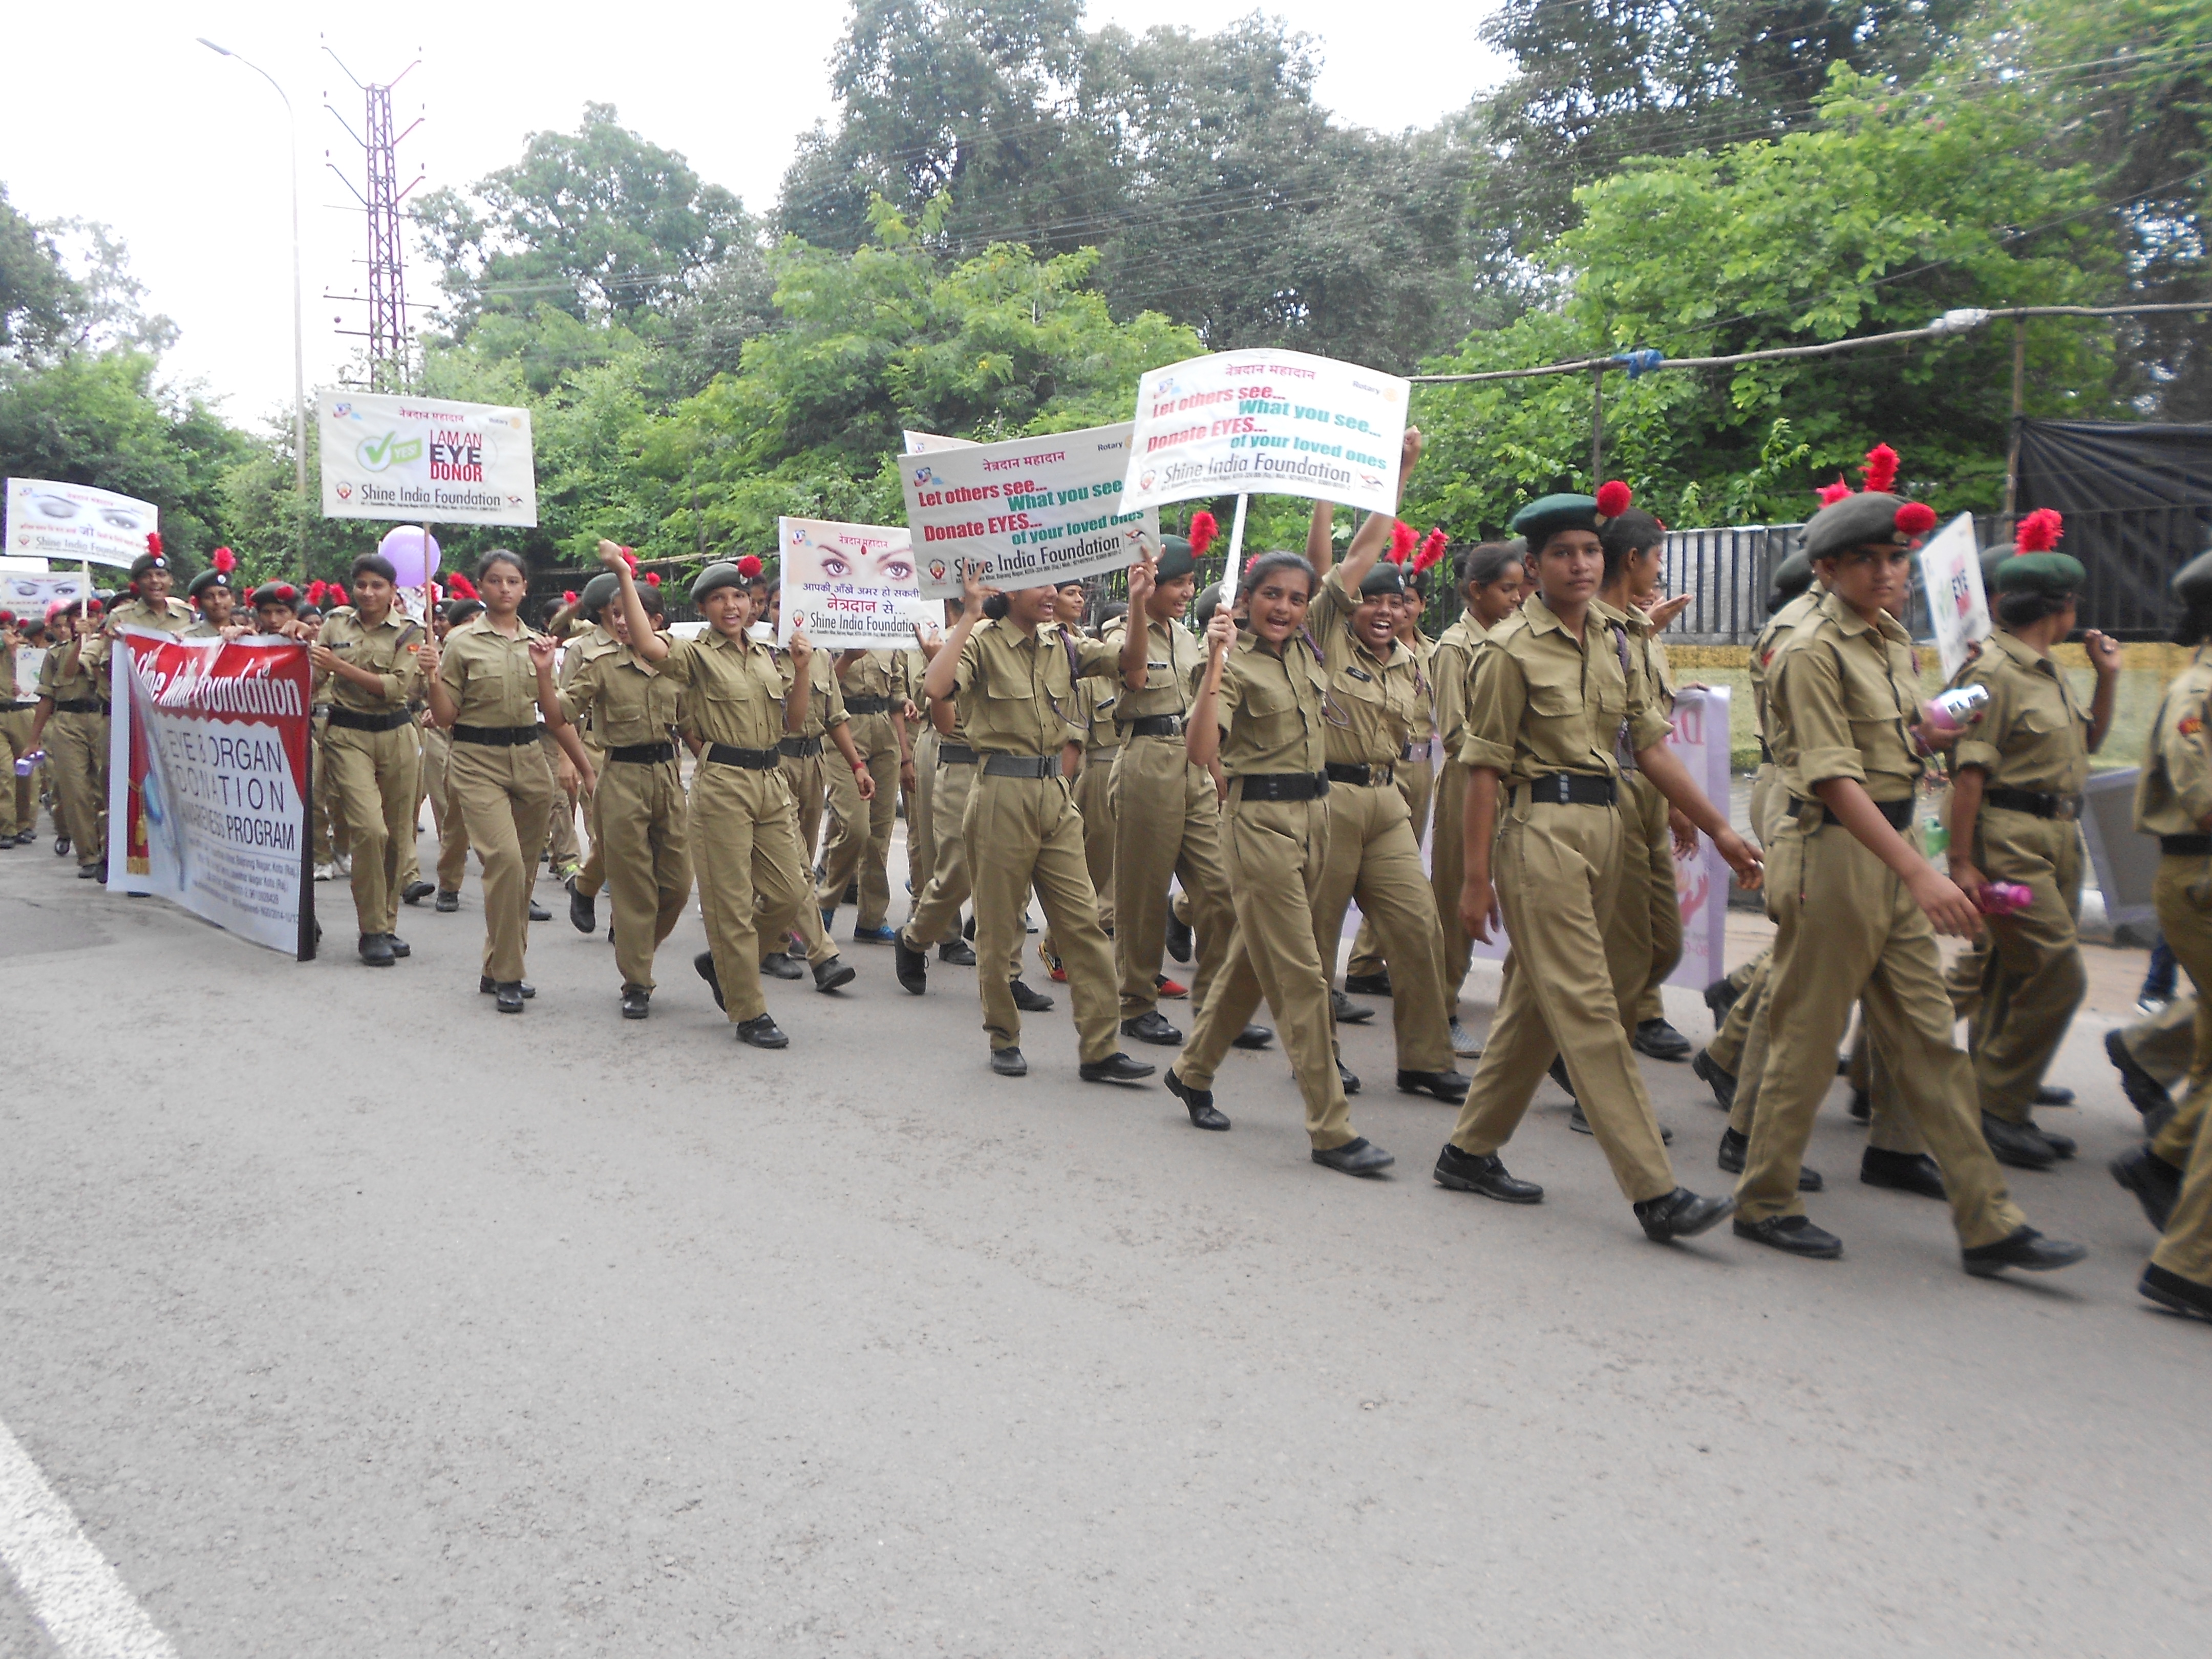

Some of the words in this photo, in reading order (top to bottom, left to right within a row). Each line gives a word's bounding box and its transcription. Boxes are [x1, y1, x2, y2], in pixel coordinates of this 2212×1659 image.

[1225, 364, 1265, 376] नेत्रदान
[1269, 365, 1316, 380] महादान
[1353, 380, 1380, 395] Rotary
[1153, 400, 1176, 418] Let
[1179, 389, 1233, 411] others
[1238, 386, 1286, 400] see...
[1239, 399, 1290, 416] What
[1294, 405, 1330, 423] you
[1334, 413, 1381, 437] see...
[430, 429, 433, 444] I
[437, 430, 459, 445] AM
[463, 432, 482, 449] AN
[1146, 426, 1207, 453] Donate
[1211, 416, 1267, 437] EYES...
[430, 443, 482, 465] EYE
[1097, 441, 1123, 452] Rotary
[1230, 434, 1248, 449] of
[1249, 435, 1290, 448] your
[1293, 436, 1343, 458] loved
[1346, 449, 1387, 470] ones
[430, 461, 483, 482] DONOR
[983, 458, 1020, 472] नेत्रदान
[1023, 451, 1066, 466] महादान
[1163, 462, 1203, 483] Shine
[1208, 453, 1248, 474] India
[1254, 453, 1351, 483] Foundation
[361, 484, 395, 500] Shine
[400, 486, 430, 503] India
[435, 488, 501, 506] Foundation
[918, 491, 943, 507] Let
[945, 484, 999, 504] others
[1003, 479, 1047, 497] see...
[1007, 491, 1054, 512] What
[1057, 486, 1089, 506] you
[924, 521, 985, 542] Donate
[988, 512, 1042, 534] EYES...
[1011, 530, 1027, 545] of
[1029, 526, 1064, 543] your
[1067, 516, 1108, 536] loved
[36, 537, 61, 547] Shine
[65, 539, 88, 550] India
[839, 533, 861, 545] नेत्रदान
[863, 539, 888, 548] महादान
[998, 550, 1035, 571] India
[1040, 538, 1119, 564] Foundation
[803, 582, 831, 593] आपकी
[857, 587, 878, 596] अमर
[882, 586, 890, 597] हो
[894, 588, 919, 598] सकती
[827, 593, 877, 613] नेत्रदान
[810, 612, 836, 629] Shine
[840, 614, 863, 630] India
[208, 735, 282, 773] ORGAN
[226, 814, 294, 852] PROGRAM
